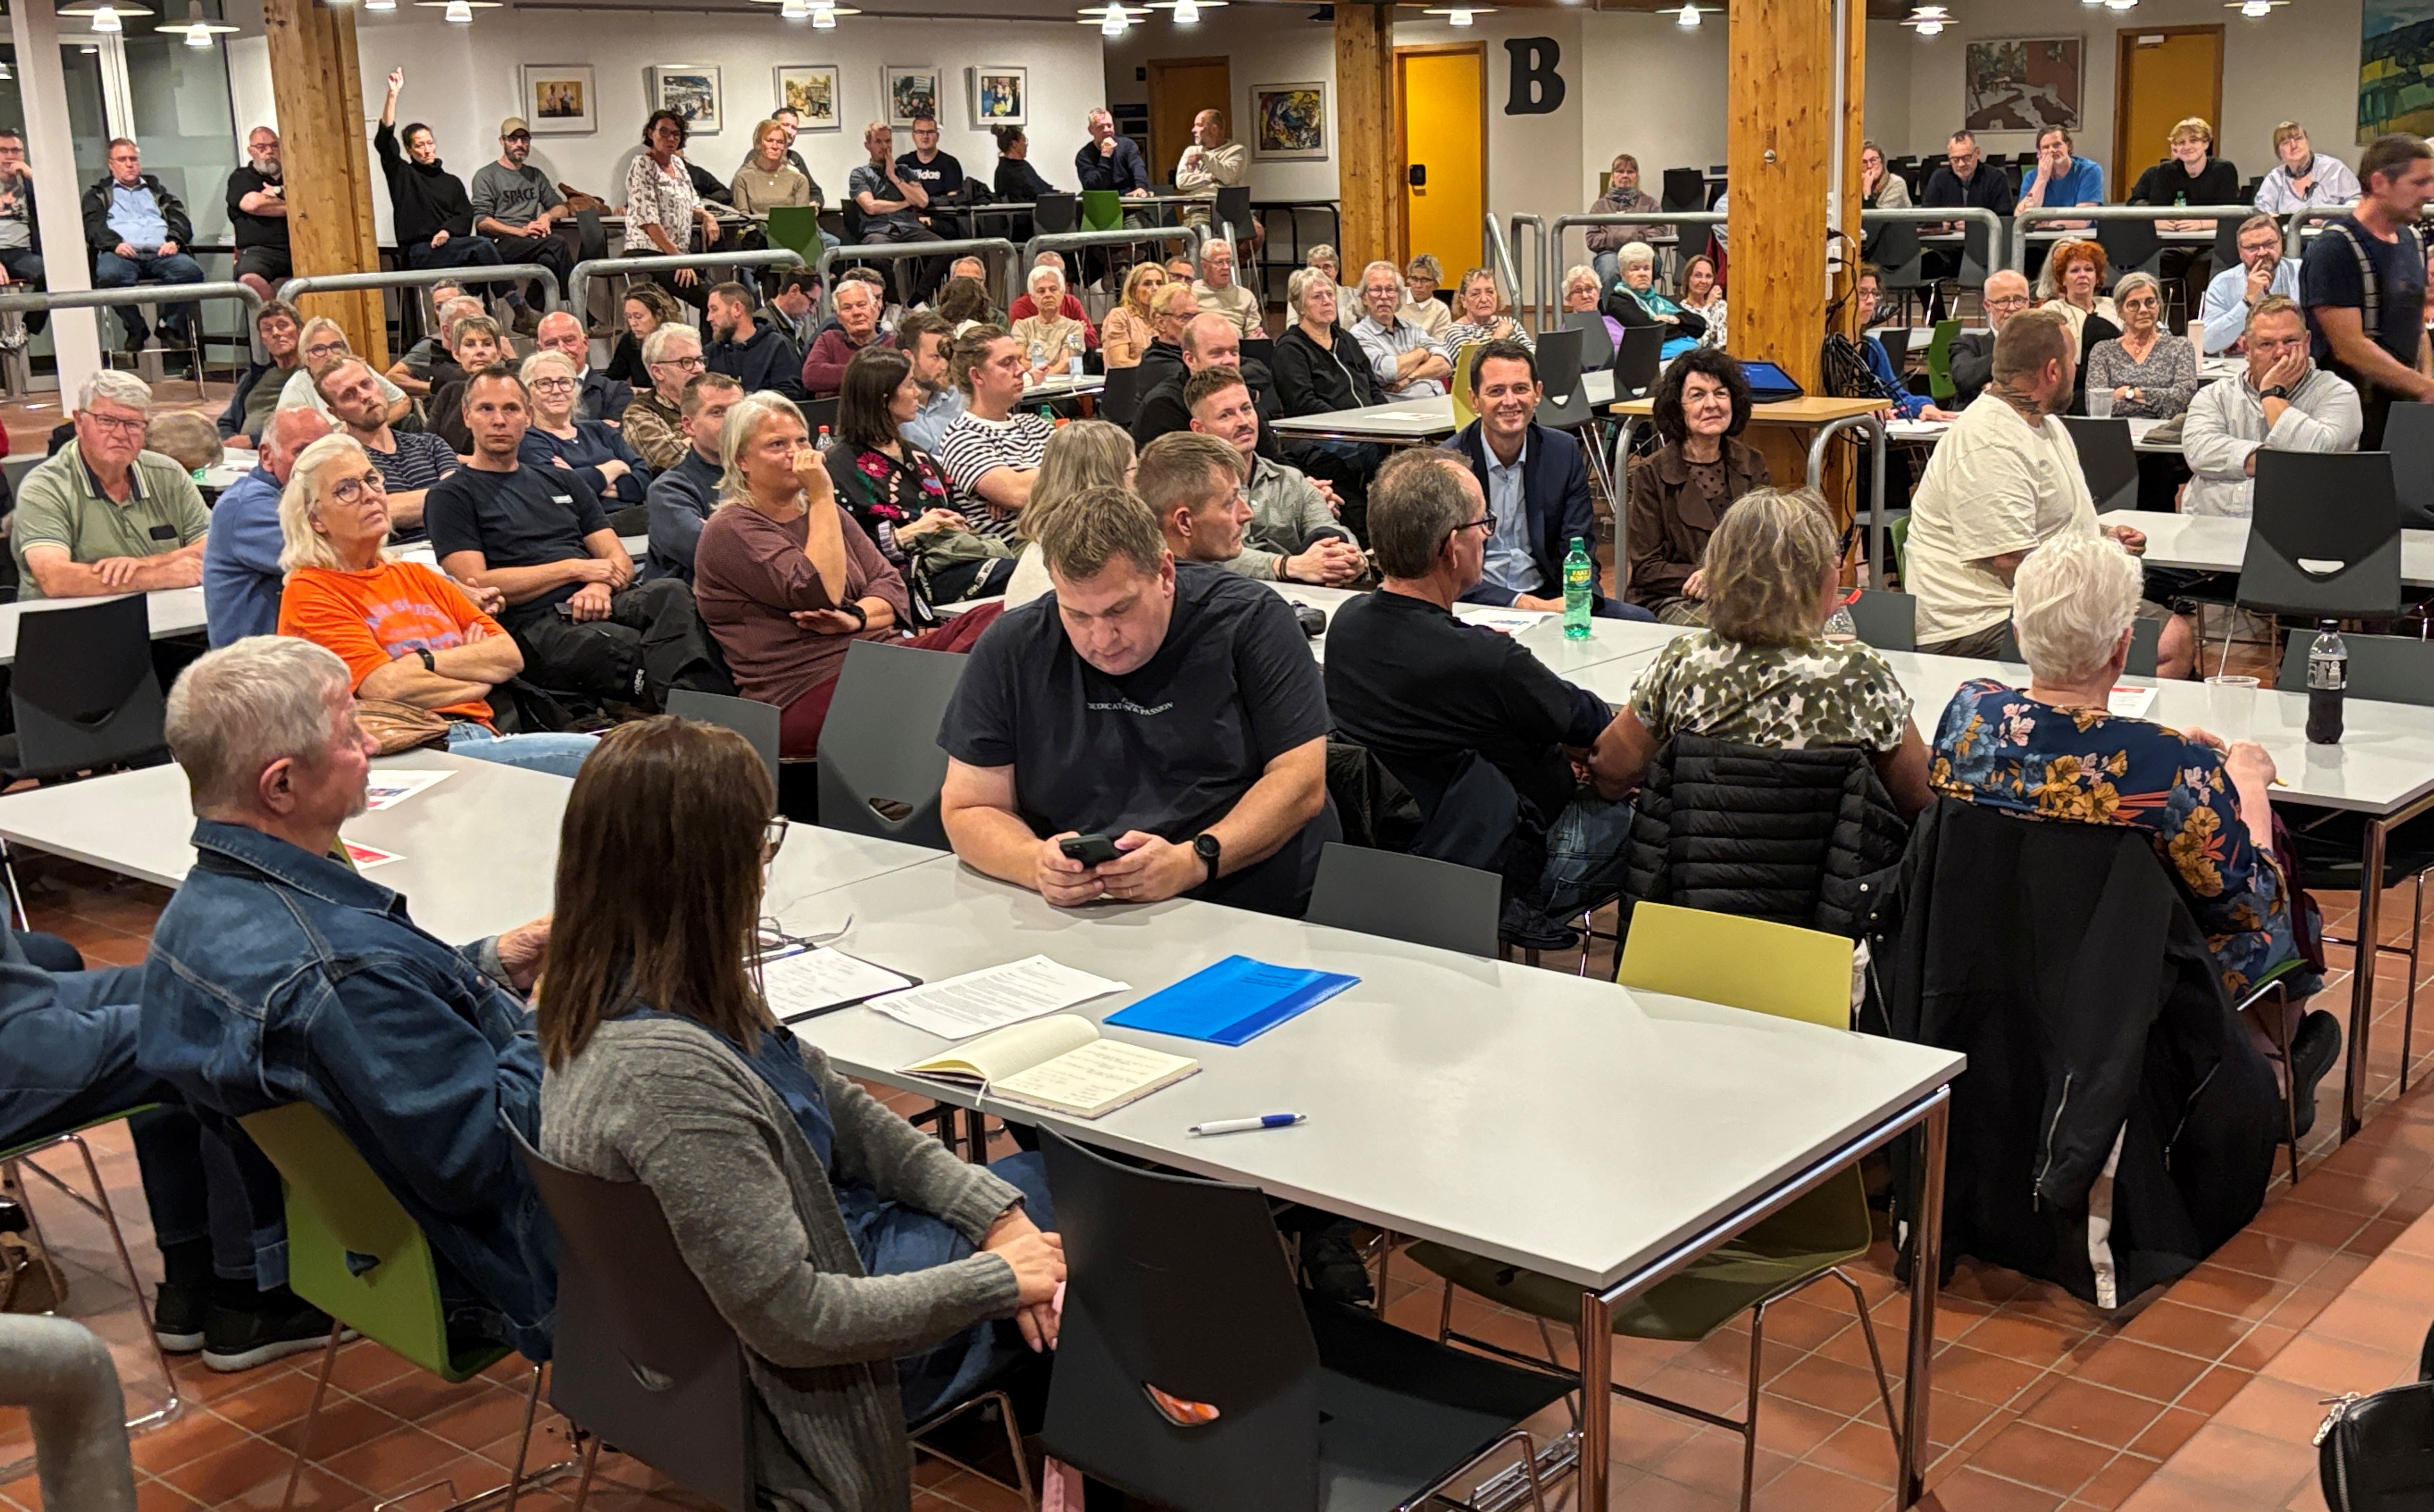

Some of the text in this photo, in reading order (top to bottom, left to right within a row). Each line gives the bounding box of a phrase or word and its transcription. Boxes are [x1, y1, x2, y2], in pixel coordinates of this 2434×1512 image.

[1504, 37, 1565, 115] B
[502, 187, 536, 203] SPACE
[1140, 702, 1173, 715] PASSION
